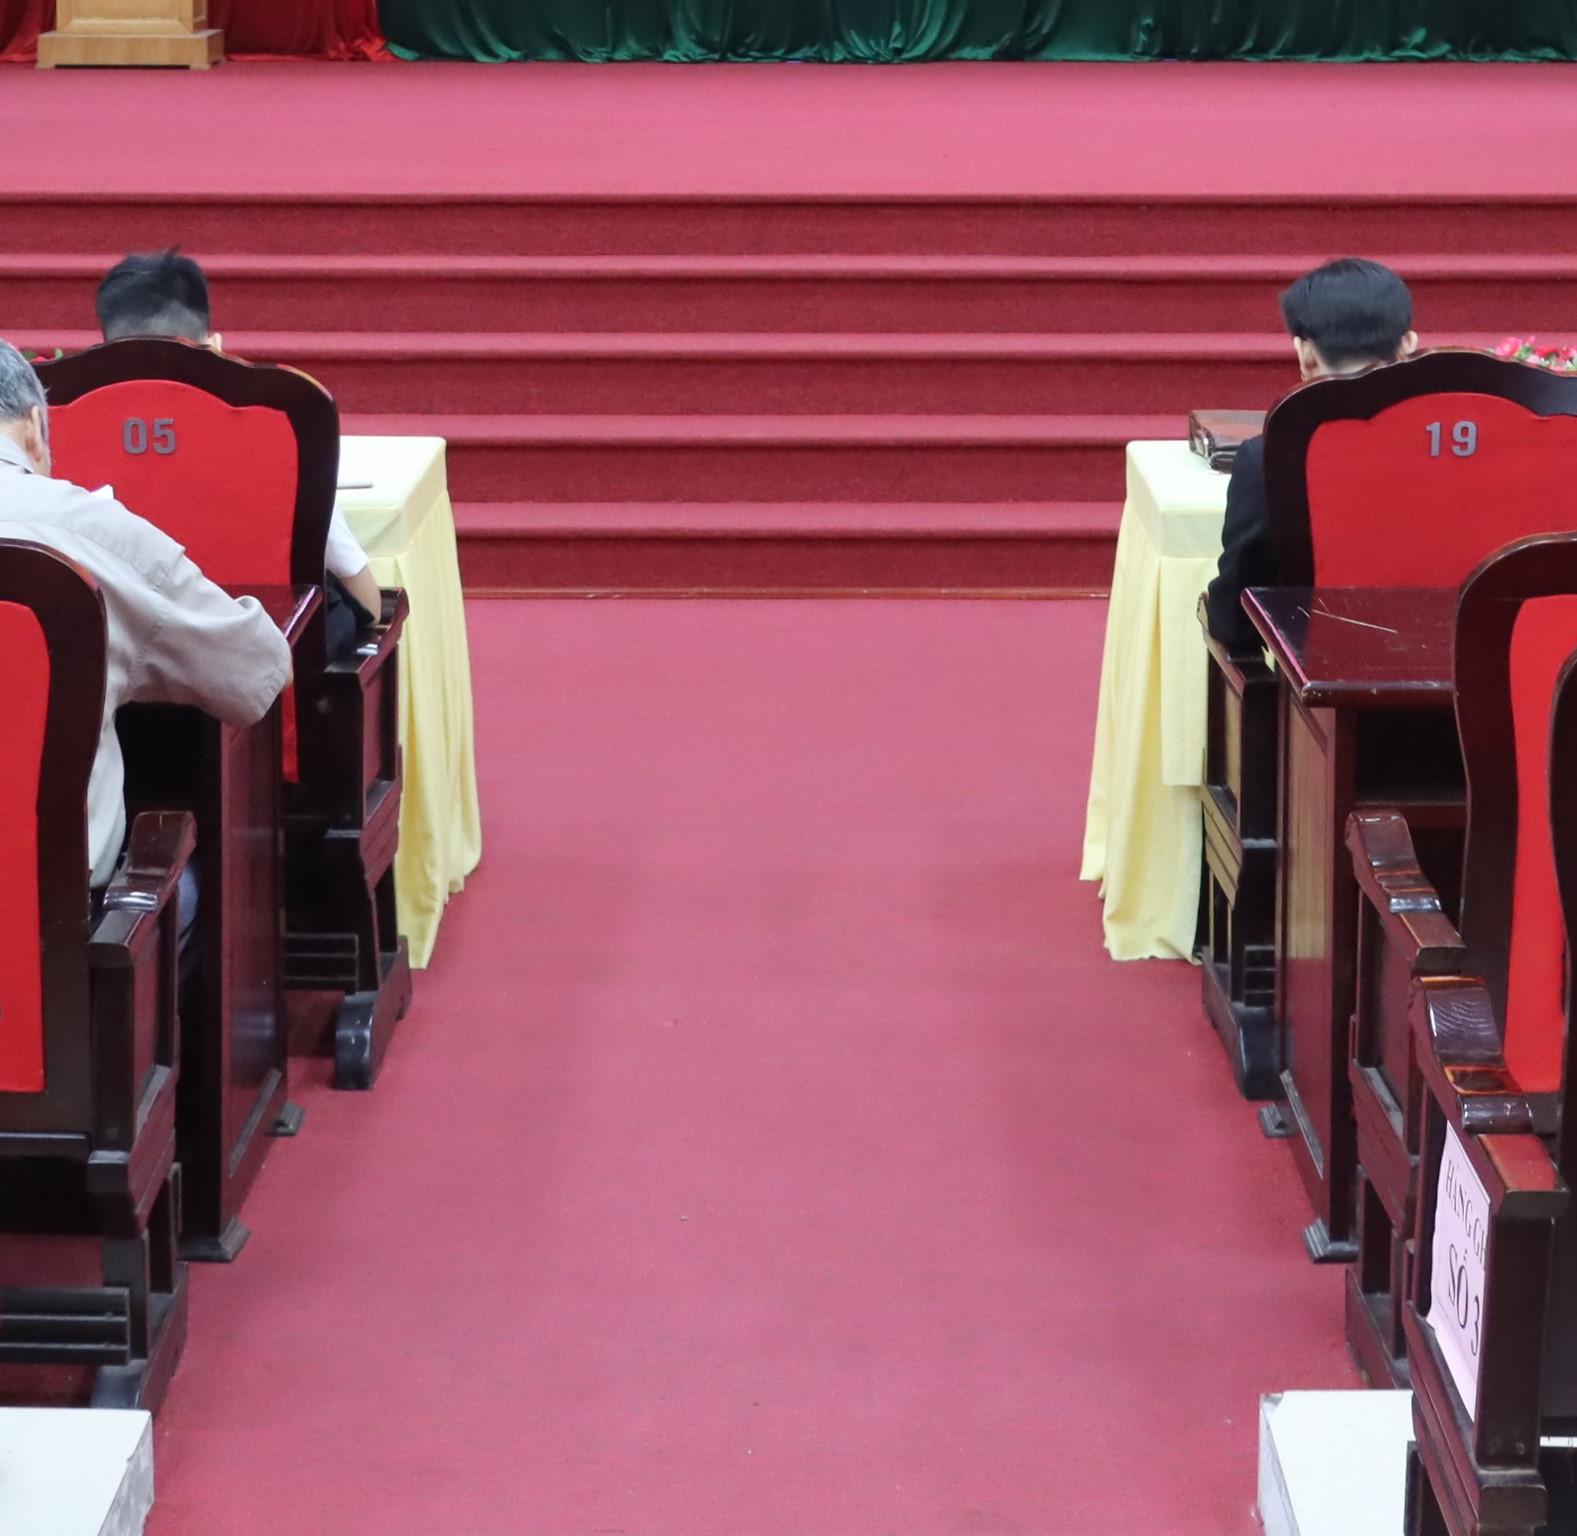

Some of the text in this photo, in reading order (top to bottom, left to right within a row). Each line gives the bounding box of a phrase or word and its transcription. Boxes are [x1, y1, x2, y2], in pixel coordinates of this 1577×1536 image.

[123, 418, 176, 454] 05
[1426, 421, 1478, 457] 19
[1445, 1159, 1473, 1239] HÀNG
[1447, 1243, 1480, 1356] SỐ 3
